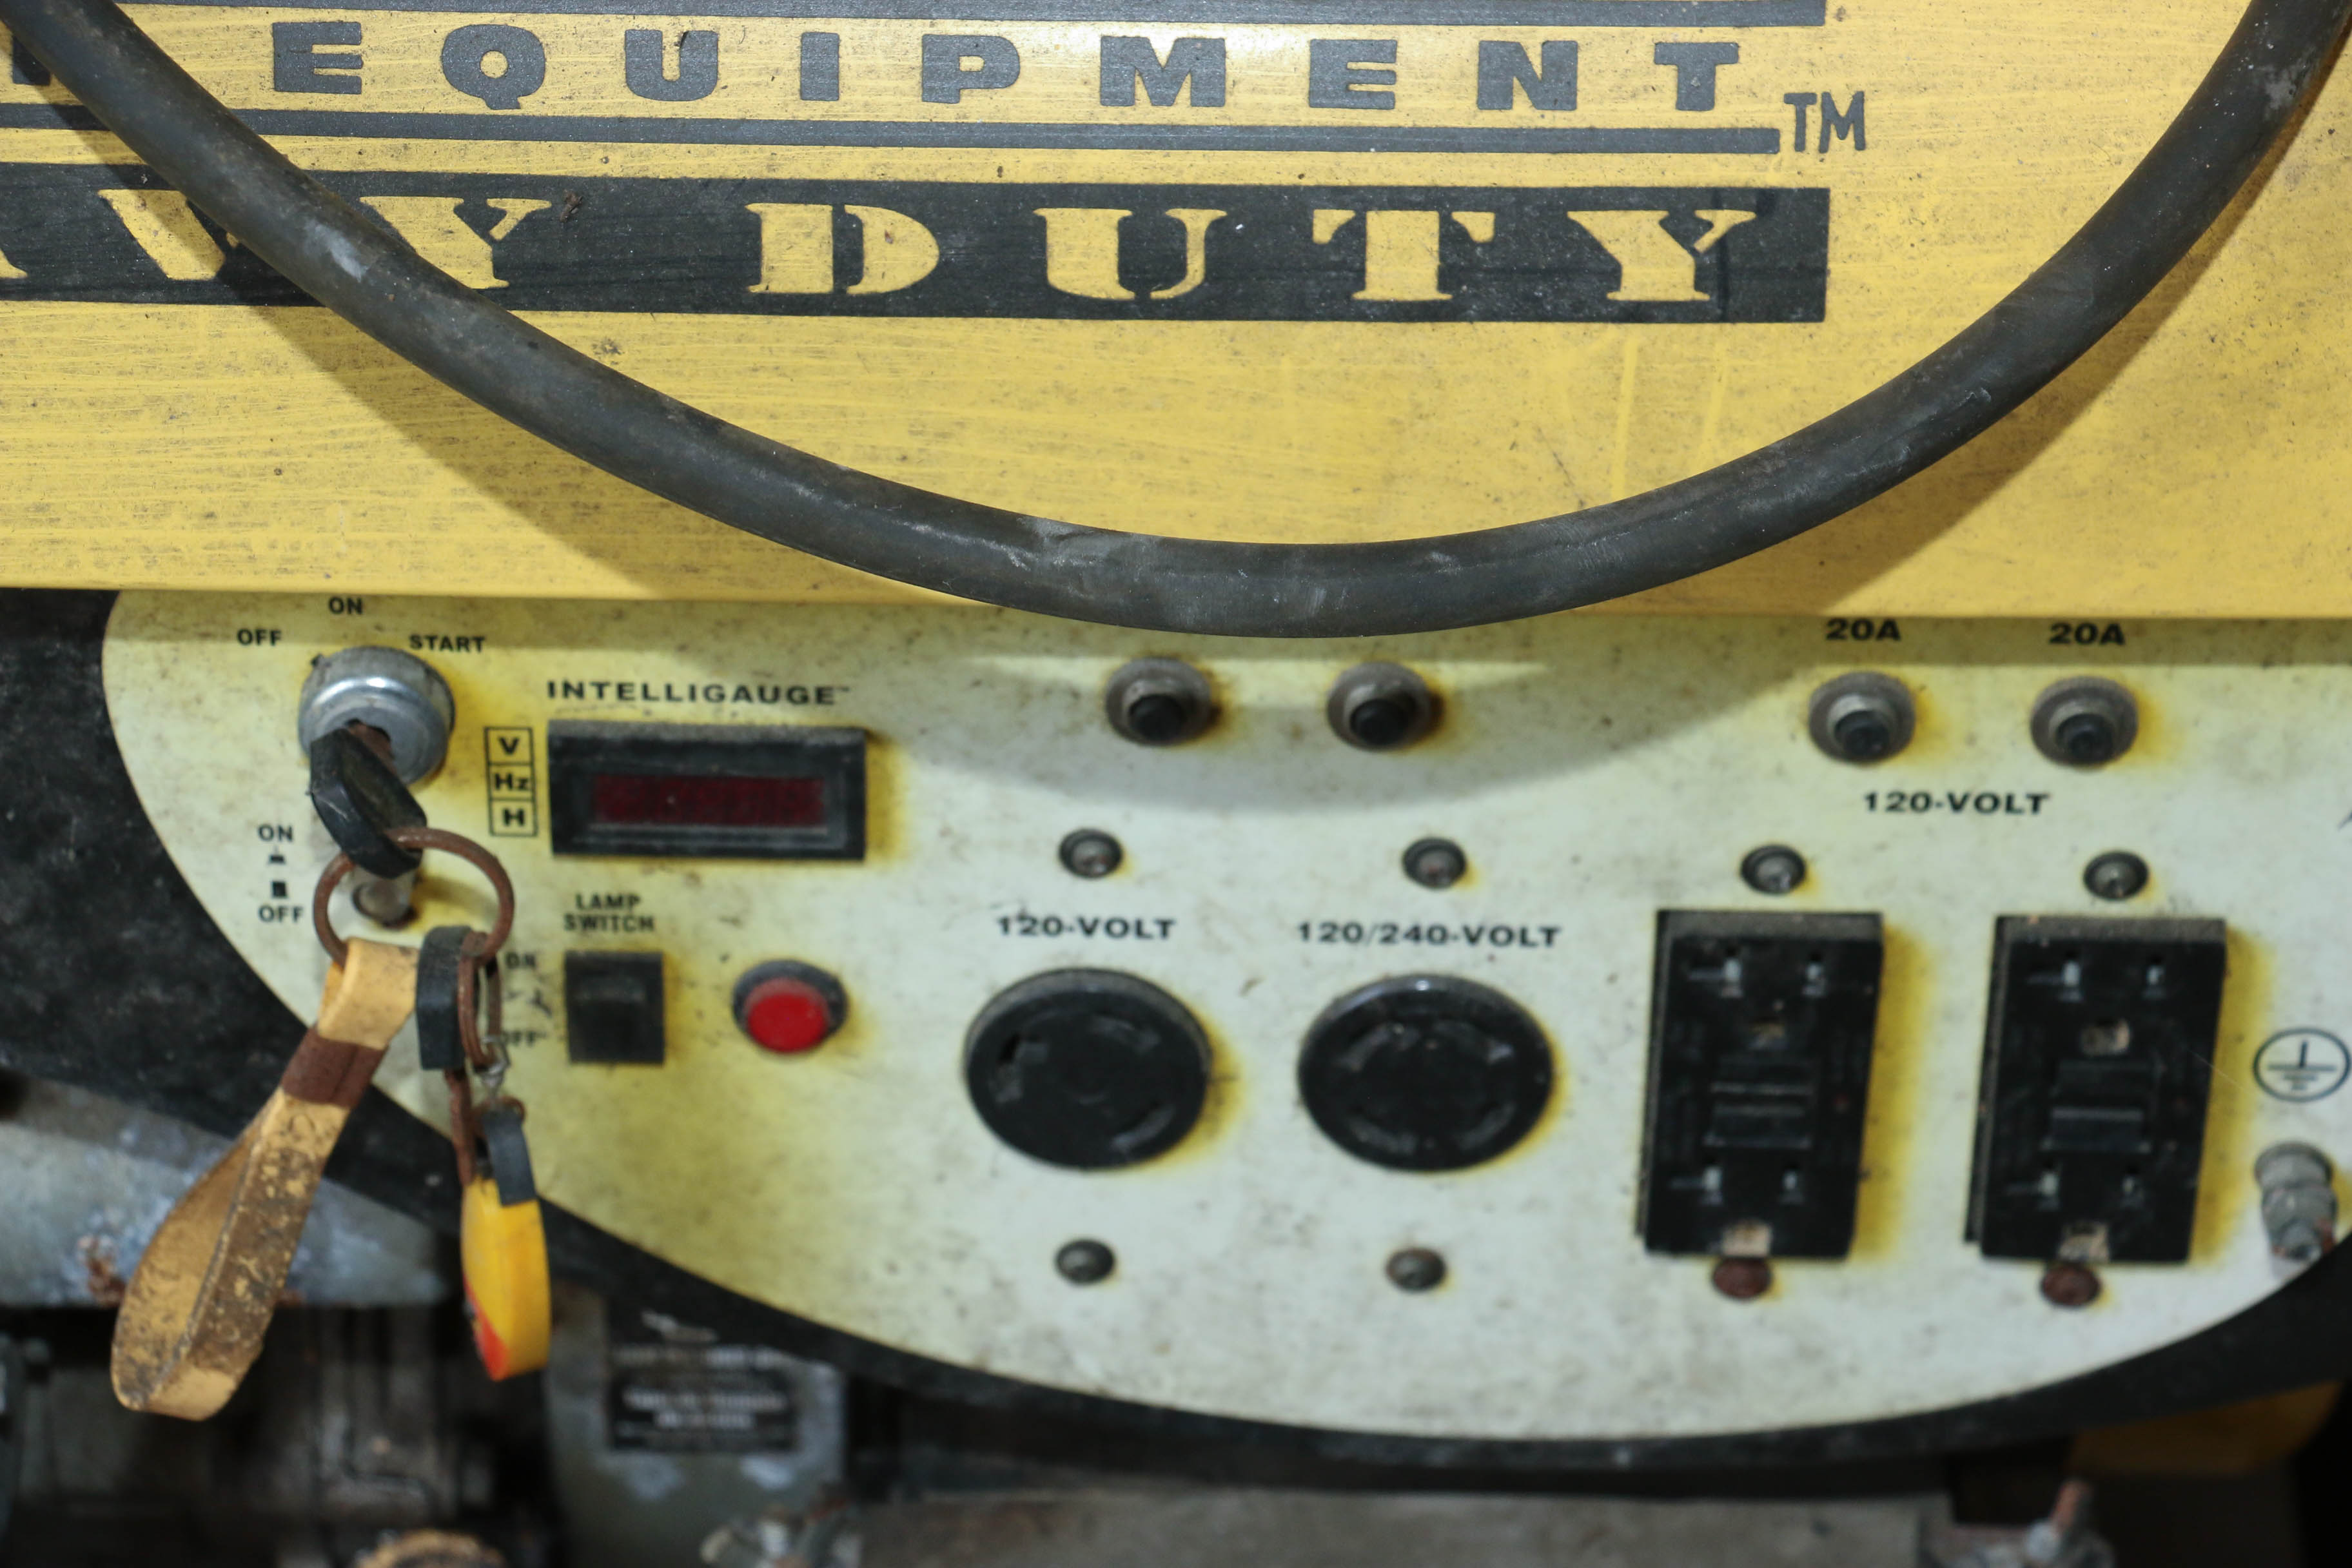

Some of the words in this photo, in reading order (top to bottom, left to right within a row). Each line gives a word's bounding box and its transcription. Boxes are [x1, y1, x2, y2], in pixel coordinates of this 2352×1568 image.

[273, 22, 1739, 110] EQUIPMENT
[1784, 91, 1865, 153] TM
[745, 203, 1756, 301] DUTY
[329, 597, 363, 614] ON
[237, 629, 282, 645] OFF
[1825, 618, 1902, 642] 20A
[2050, 623, 2126, 645] 20A
[409, 634, 486, 652] START
[547, 681, 836, 705] INTELLIGAUGE
[498, 737, 520, 755] V
[495, 773, 529, 790] Hz
[1864, 792, 2051, 815] 120-VOLT
[503, 808, 525, 826] H
[259, 825, 293, 842] ON
[576, 893, 641, 910] LAMP
[259, 905, 303, 923] OFF
[564, 914, 655, 930] SWITCH
[998, 916, 1176, 940] 120-VOLT
[1297, 921, 1563, 947] 120/240-VOLT
